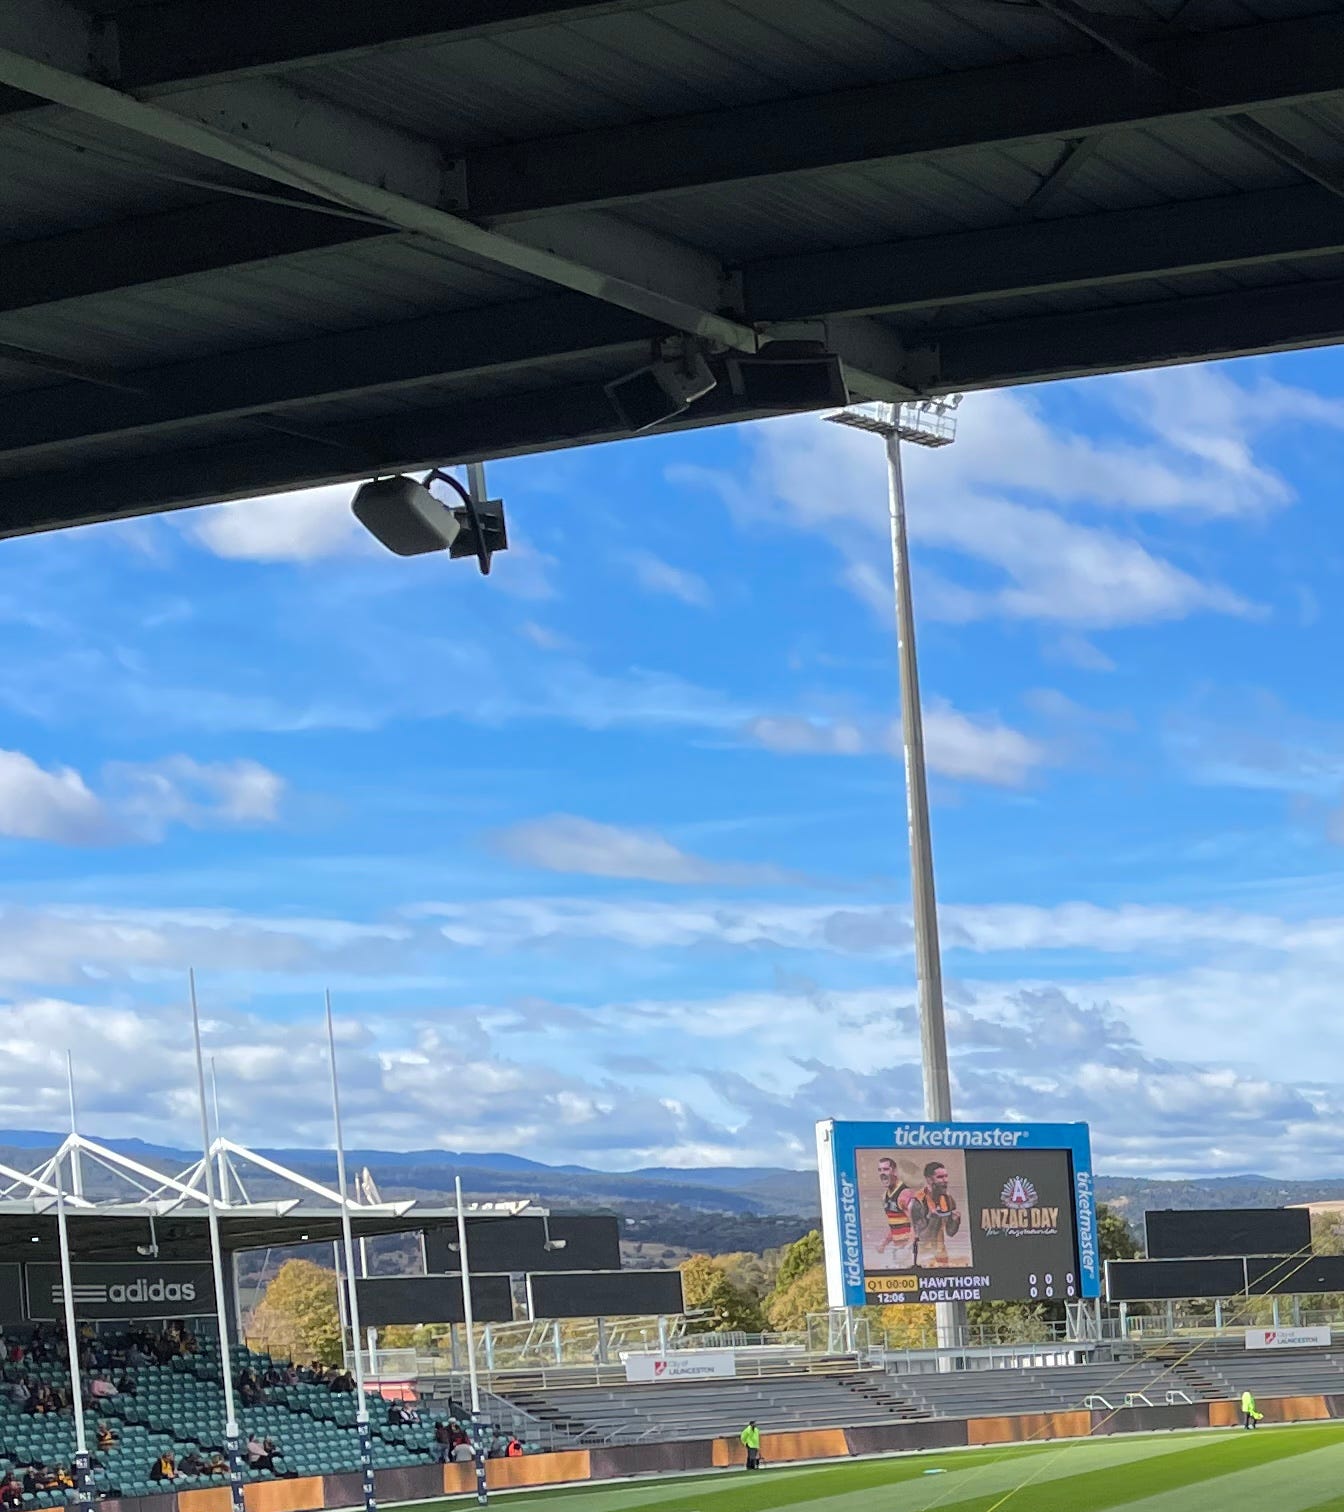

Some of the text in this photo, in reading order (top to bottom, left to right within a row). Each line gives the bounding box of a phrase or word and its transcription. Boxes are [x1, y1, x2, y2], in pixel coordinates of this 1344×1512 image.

[894, 1125, 1023, 1147] ticketmaster
[981, 1207, 1059, 1229] ANZAC DAY
[1076, 1171, 1096, 1274] ticketmaster
[845, 1178, 862, 1288] ticketmaster
[867, 1278, 915, 1291] Q1 00:00
[919, 1272, 1074, 1288] HAWTHORN 0 0 0
[109, 1278, 196, 1302] adidas
[877, 1292, 905, 1303] 12:06
[919, 1285, 1075, 1301] ADELAIDE 0 0 0
[669, 1367, 714, 1375] LAUNCESTON
